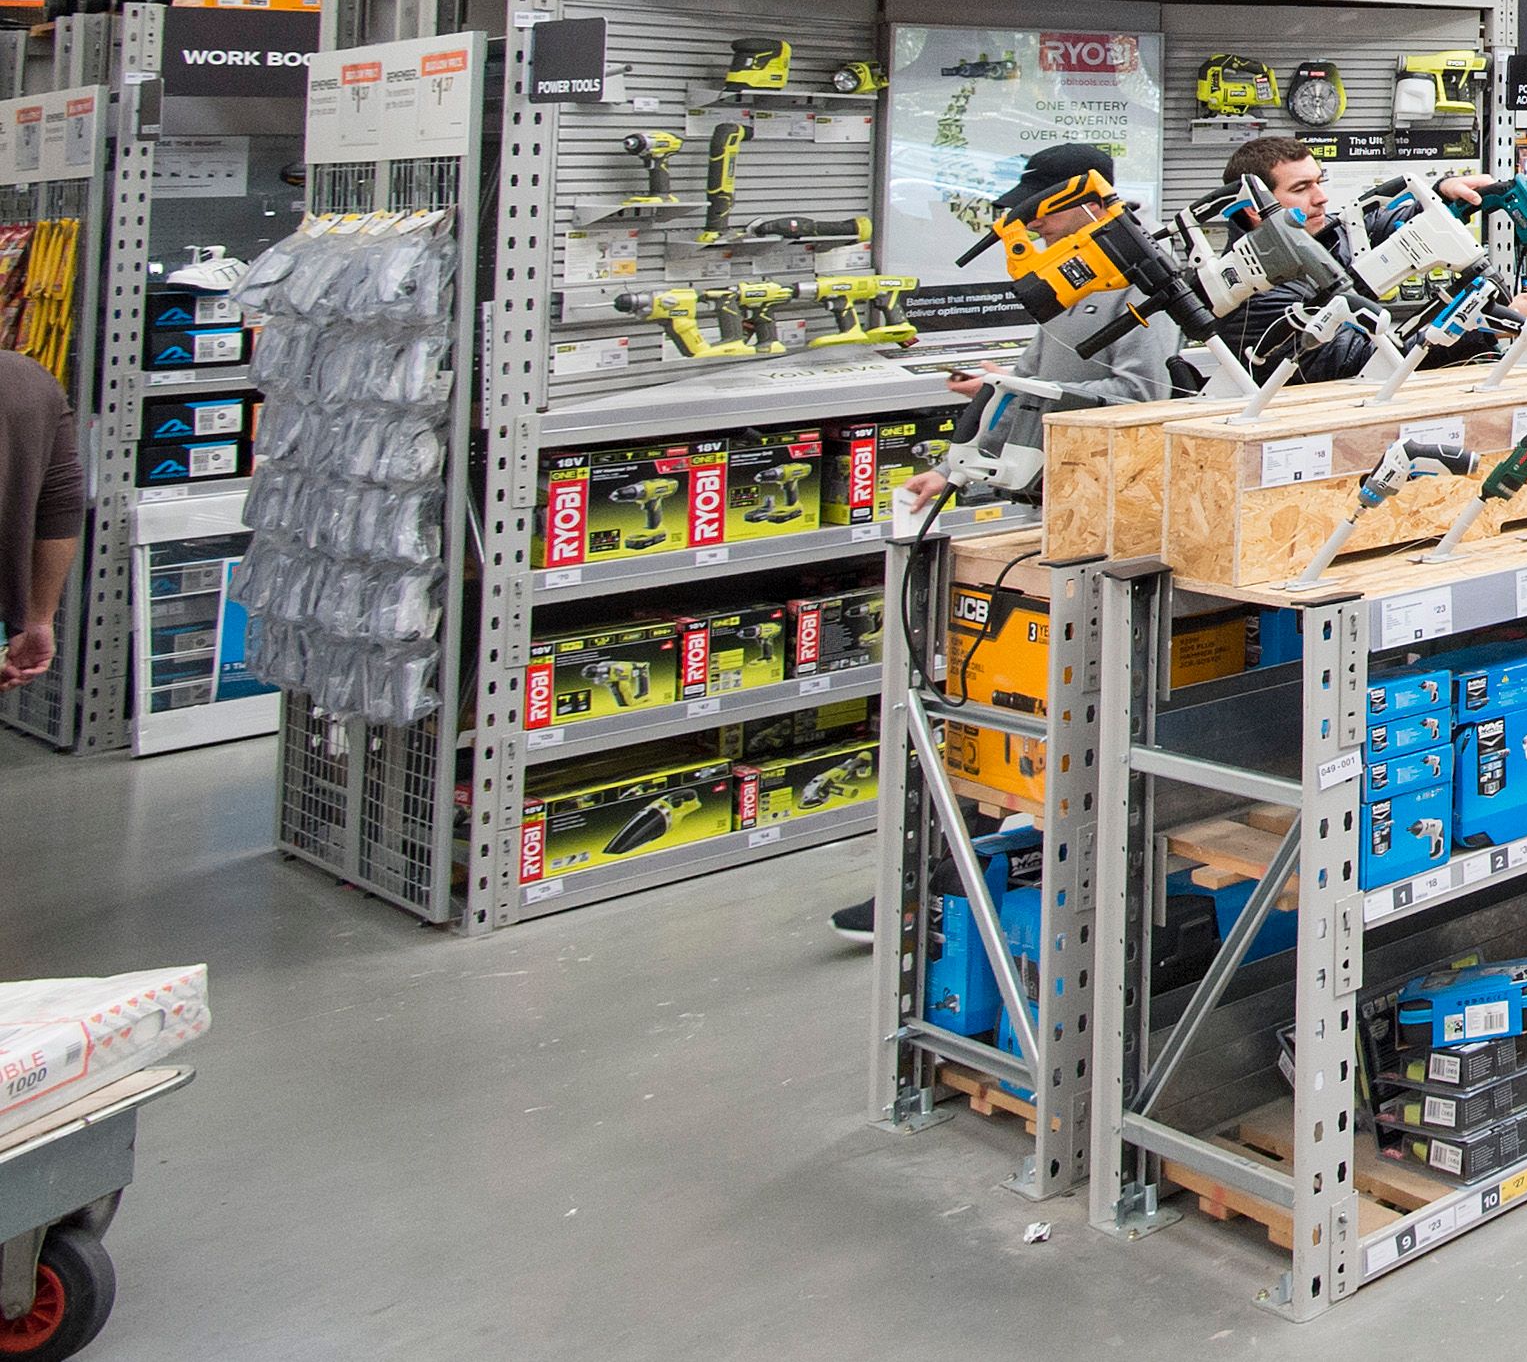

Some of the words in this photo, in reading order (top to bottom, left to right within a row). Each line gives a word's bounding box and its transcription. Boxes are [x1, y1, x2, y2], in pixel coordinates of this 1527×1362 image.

[182, 50, 261, 66] WORK
[1045, 41, 1131, 66] RYOBI
[538, 81, 570, 93] POWER
[571, 79, 600, 92] TOOLS
[1036, 101, 1064, 110] ONE
[1071, 101, 1128, 110] BATTERY
[1055, 116, 1128, 126] POWERING
[1020, 131, 1057, 140] OVER
[1084, 130, 1127, 139] TOOLS
[906, 296, 946, 307] Batteries
[948, 296, 965, 304] that
[966, 294, 997, 304] manage
[998, 292, 1017, 301] th
[906, 308, 936, 318] deliver
[938, 306, 980, 316] optimum
[759, 368, 815, 381] You
[822, 361, 885, 374] save
[855, 429, 873, 437] 18V
[880, 424, 915, 436] ONE+
[697, 443, 722, 452] 18V
[557, 457, 584, 467] 18V
[854, 447, 872, 503] RYOBI
[695, 470, 720, 541] RYOBI
[553, 486, 582, 560] RYOBI
[955, 596, 990, 623] JCB
[1434, 604, 1447, 615] £23
[801, 614, 818, 660] RYOBI
[531, 646, 552, 655] 18V
[687, 633, 705, 683] RYOBI
[530, 670, 548, 721] RYOBI
[743, 784, 757, 819] RYOBI
[524, 806, 543, 814] 18V
[523, 825, 542, 878] RYOBI
[1496, 855, 1504, 868] 2
[1425, 878, 1438, 888] £18
[1398, 890, 1407, 904] 1
[6, 1068, 47, 1096] 1000
[1512, 1175, 1525, 1189] £27
[1483, 1192, 1498, 1207] 10
[1428, 1218, 1442, 1231] £23
[1401, 1235, 1412, 1250] 9
